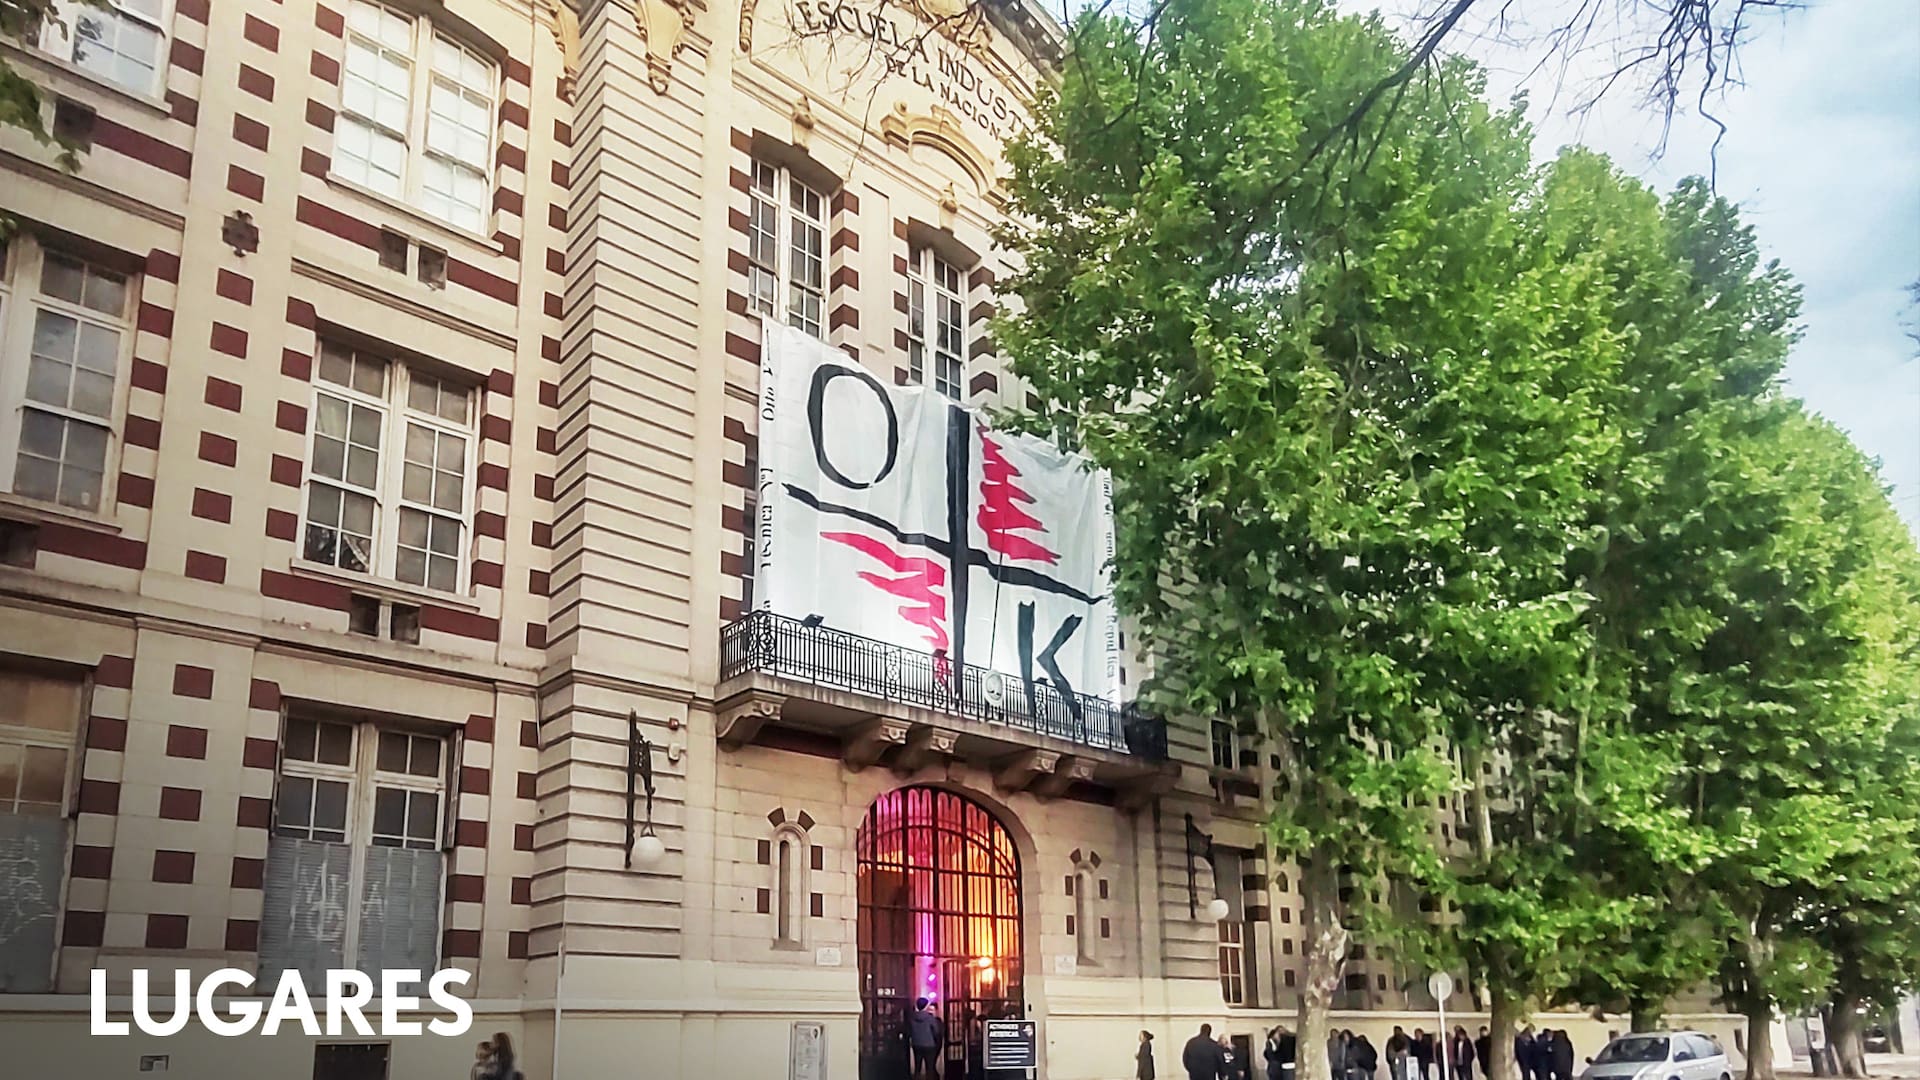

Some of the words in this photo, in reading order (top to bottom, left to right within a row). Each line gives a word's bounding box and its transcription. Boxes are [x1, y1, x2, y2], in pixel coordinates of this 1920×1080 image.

[795, 2, 930, 64] ESCUELA
[884, 54, 907, 77] DE
[911, 66, 935, 93] LA
[806, 363, 899, 490] O
[1017, 600, 1084, 719] K
